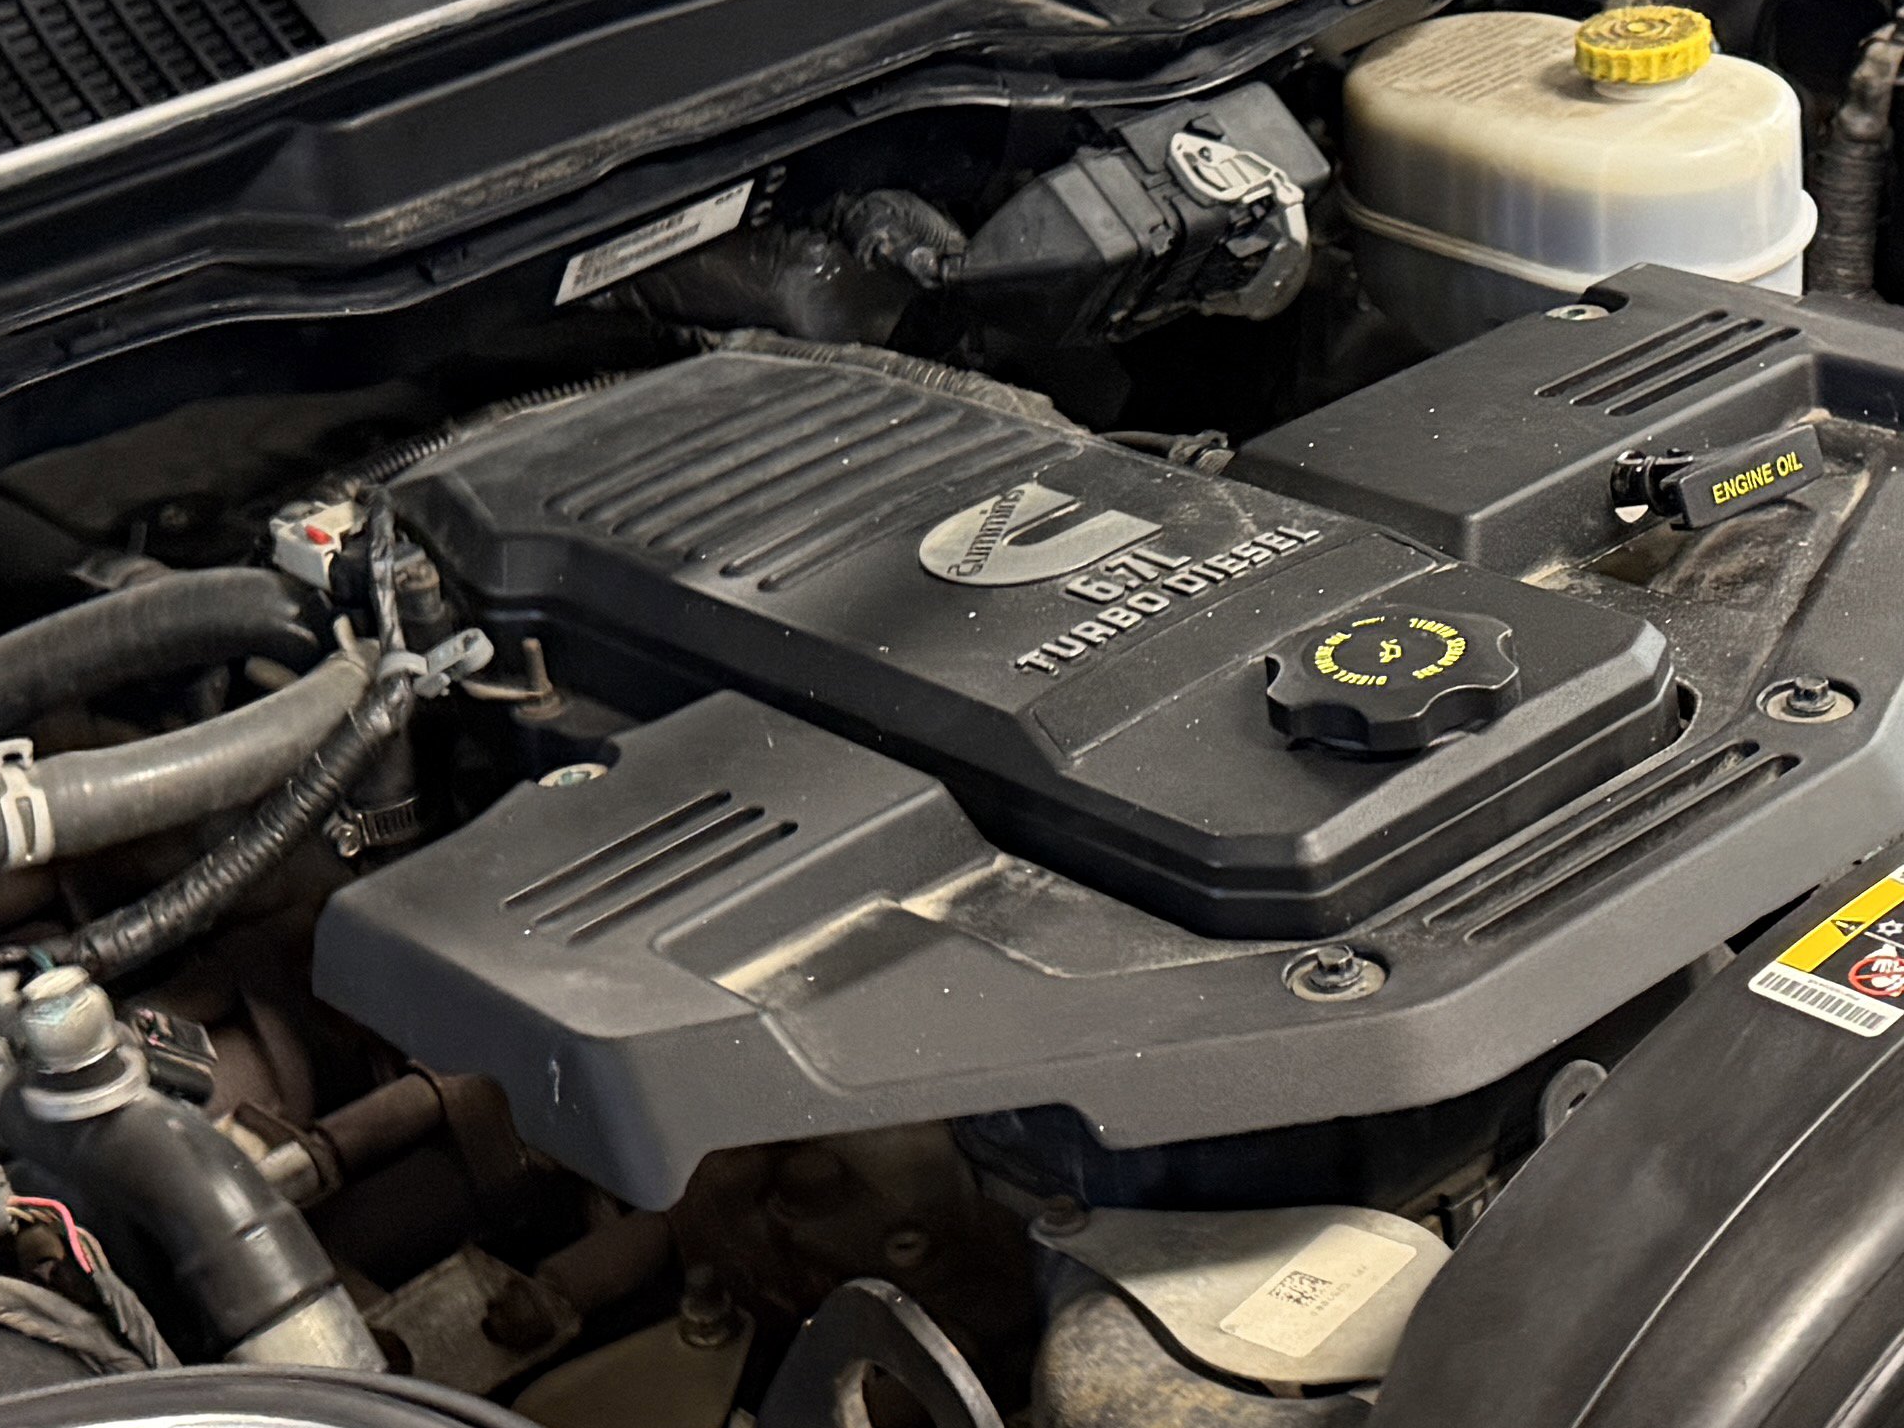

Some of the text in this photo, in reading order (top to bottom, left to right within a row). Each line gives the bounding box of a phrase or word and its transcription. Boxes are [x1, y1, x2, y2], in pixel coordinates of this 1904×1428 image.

[1712, 451, 1804, 504] ENGINE OIL
[1014, 523, 1322, 677] TURBO DIESEL
[1066, 546, 1194, 604] 6.7L
